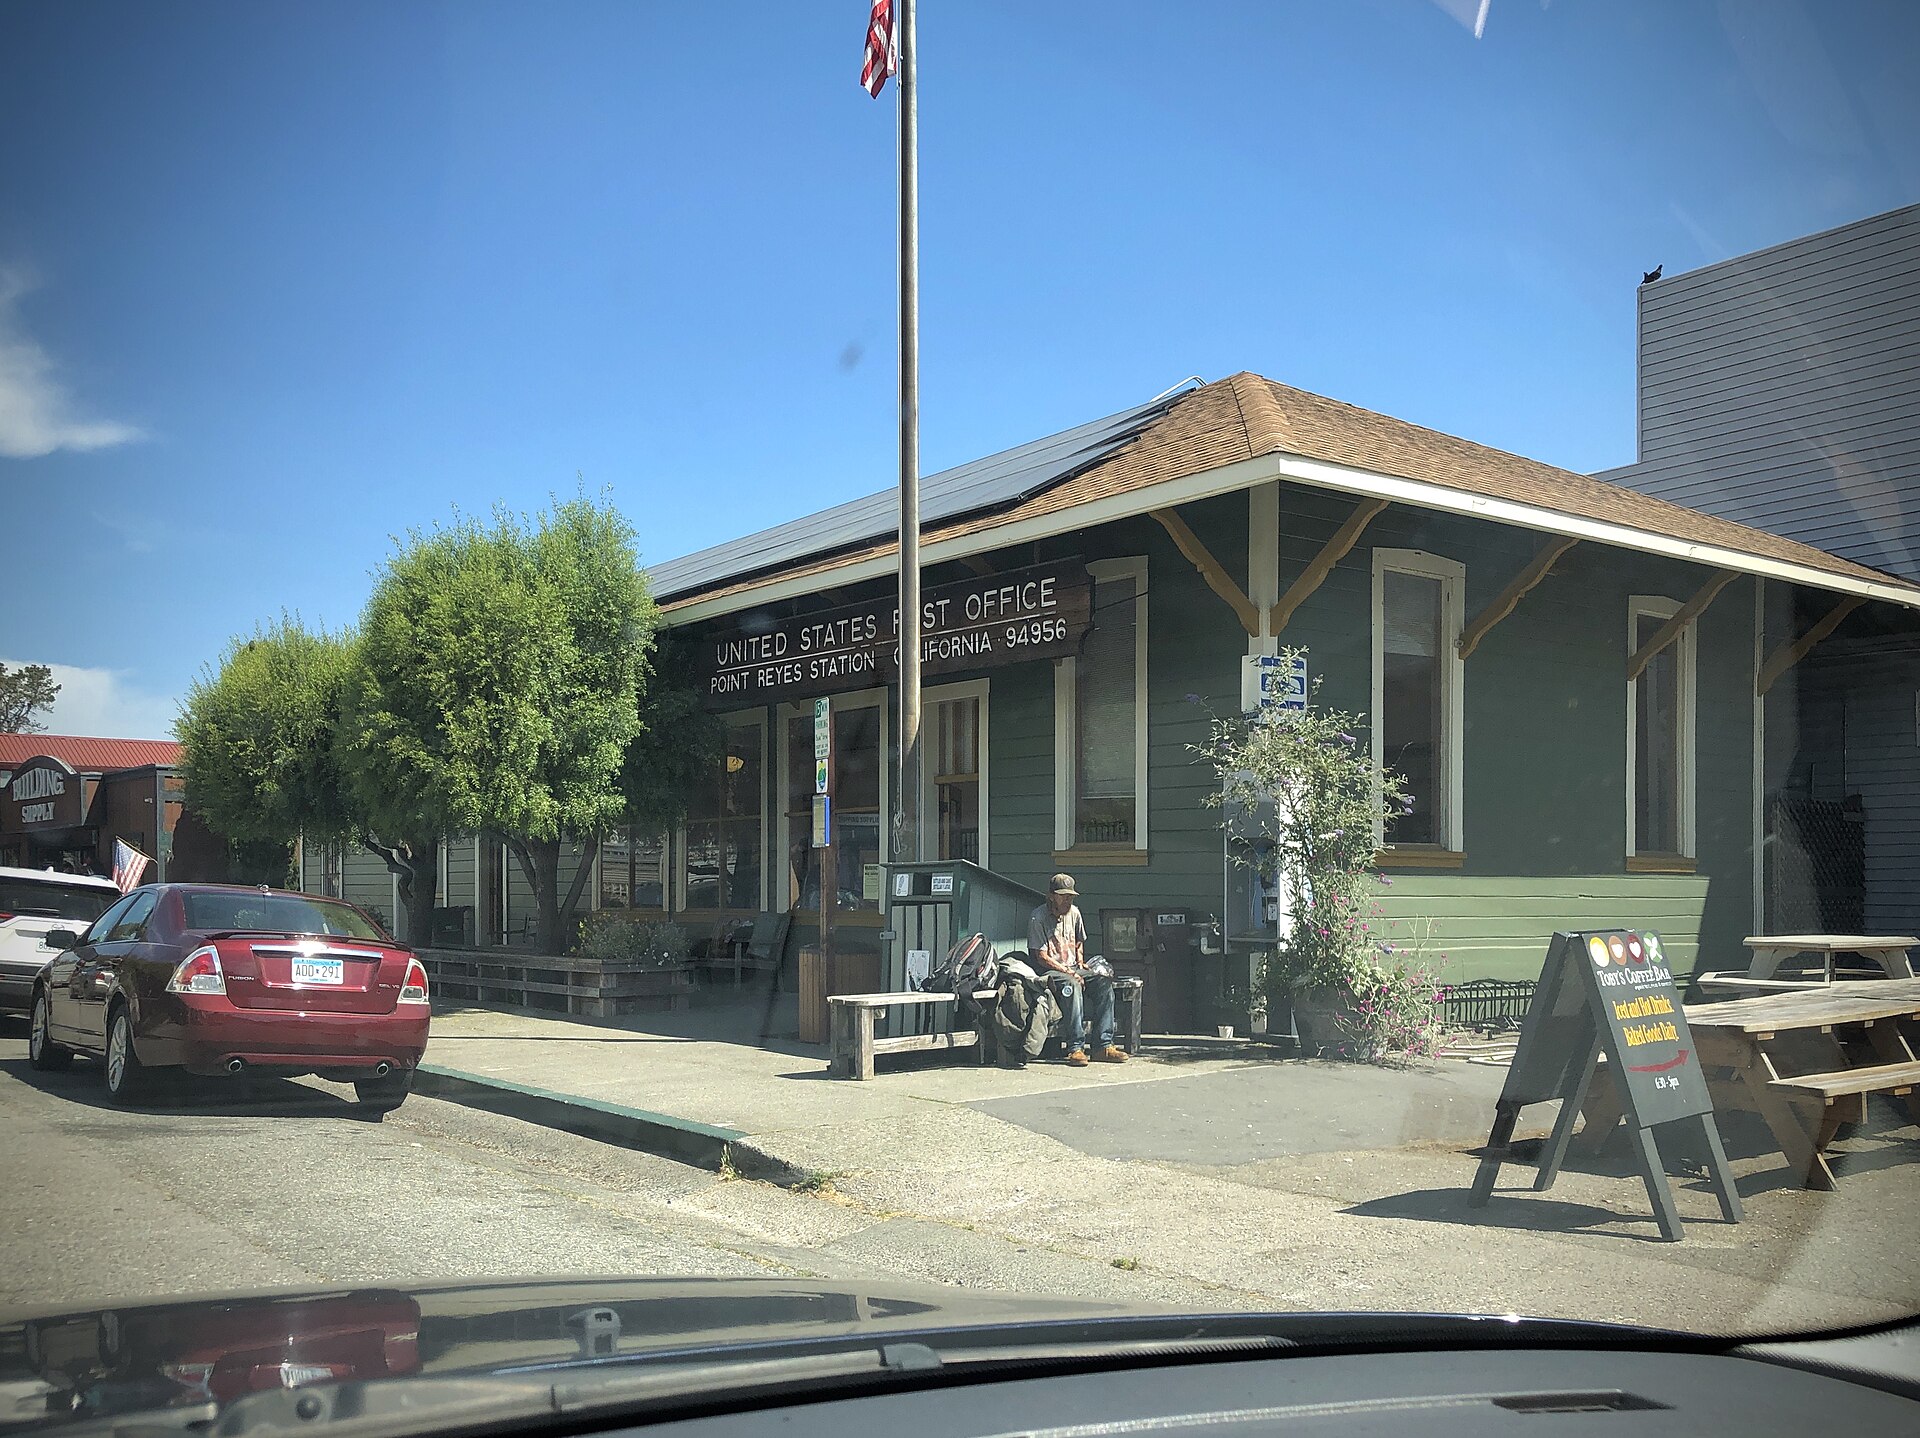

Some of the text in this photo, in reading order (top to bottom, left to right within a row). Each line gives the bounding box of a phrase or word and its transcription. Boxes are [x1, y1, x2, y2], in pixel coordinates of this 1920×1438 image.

[716, 576, 1058, 666] UNITED STATES PST OFFICE
[710, 671, 750, 695] POINT
[757, 662, 802, 688] REYES
[809, 650, 876, 680] STATION
[1005, 617, 1068, 649] 94956
[12, 767, 66, 802] BUILDING
[21, 801, 56, 823] SUPPLY
[321, 965, 341, 979] 291
[1596, 970, 1626, 987] TOBY'S
[1624, 967, 1656, 985] COFFEE
[1651, 965, 1672, 982] BAR
[1612, 999, 1631, 1020] Iced
[1628, 997, 1643, 1018] and
[1638, 996, 1654, 1016] Hot
[1622, 1024, 1647, 1047] Baked
[1642, 1022, 1664, 1043] Goods
